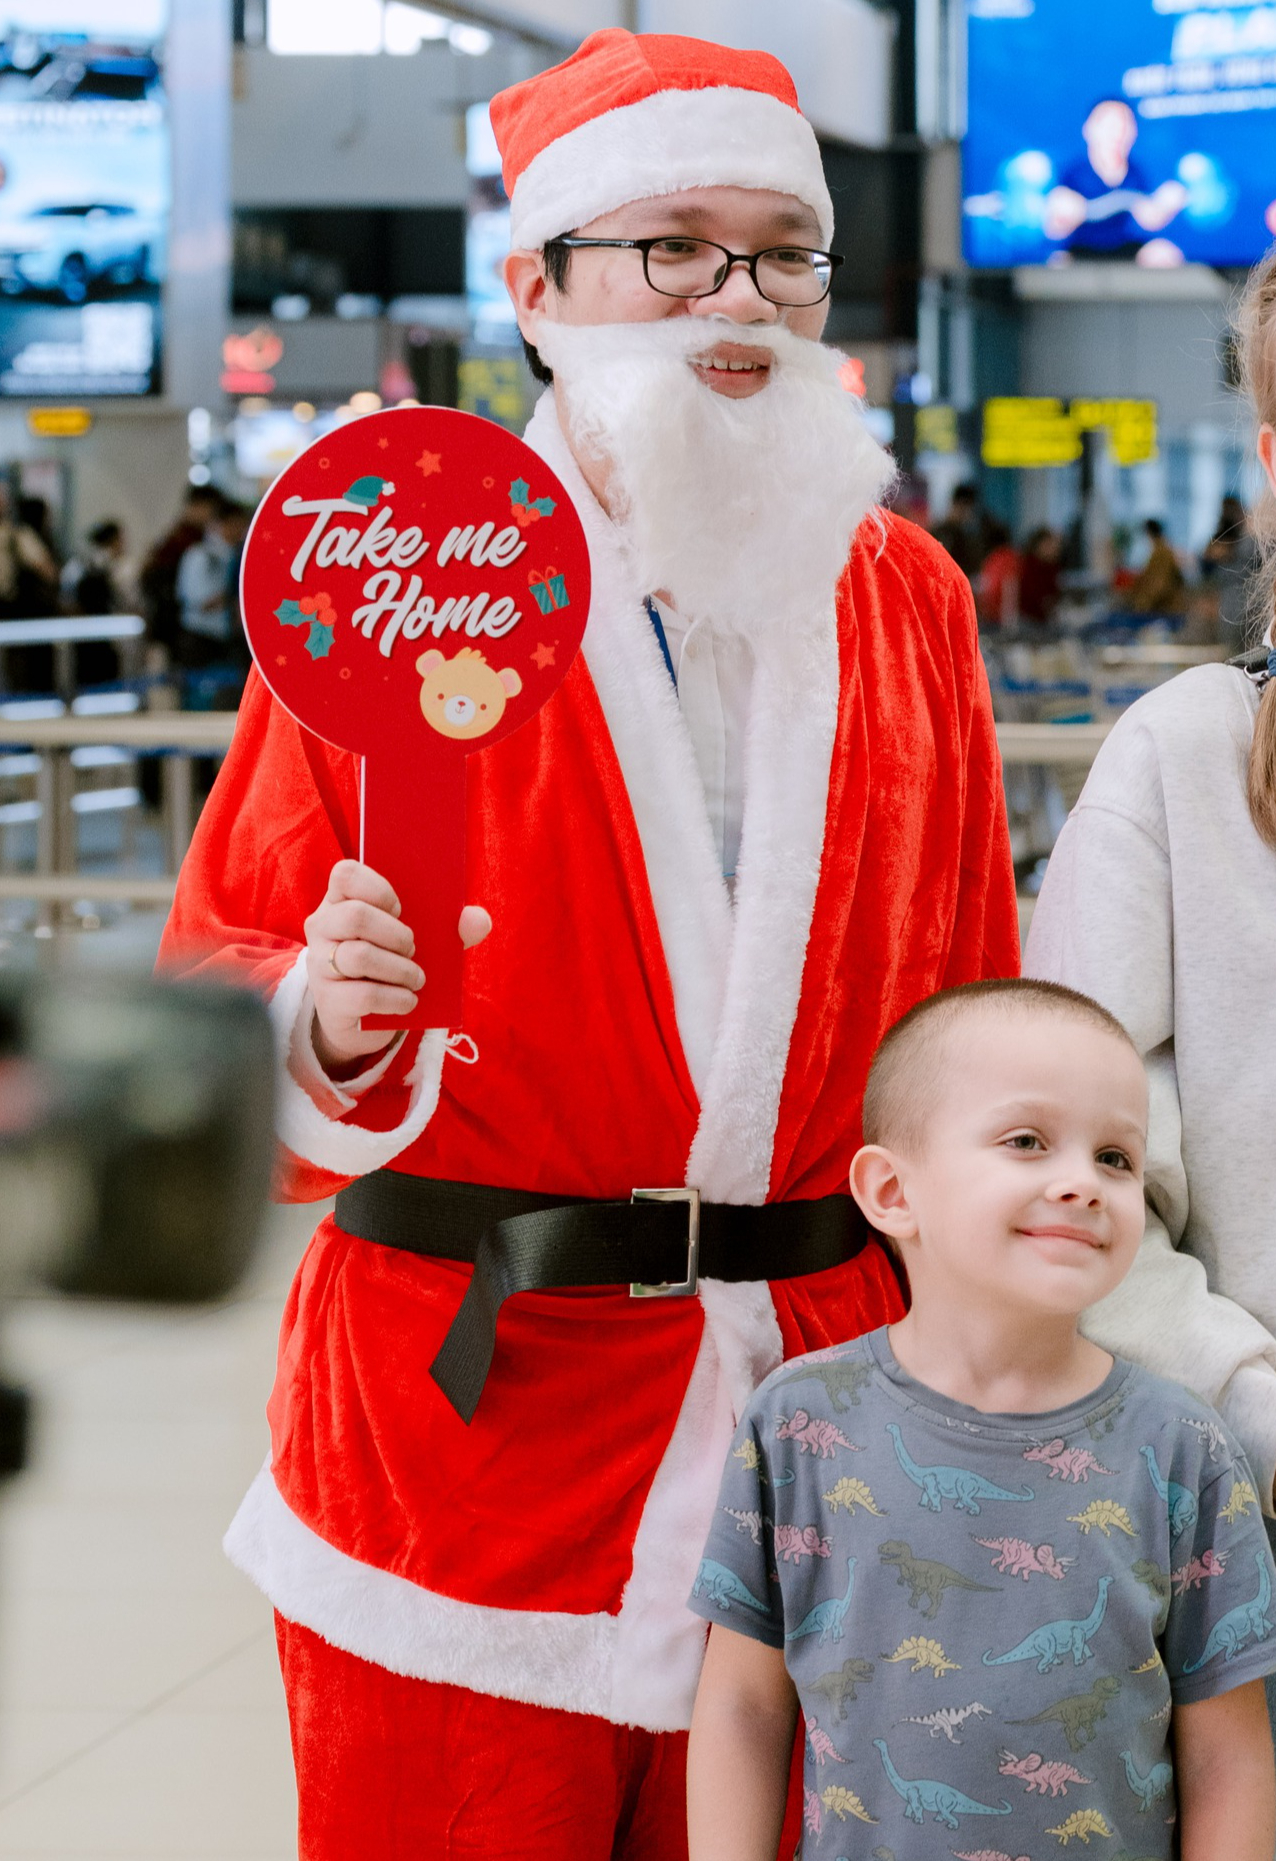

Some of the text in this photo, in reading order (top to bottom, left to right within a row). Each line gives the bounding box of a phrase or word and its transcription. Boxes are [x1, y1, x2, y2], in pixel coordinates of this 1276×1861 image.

[282, 495, 527, 582] Take me
[351, 570, 522, 658] Home
